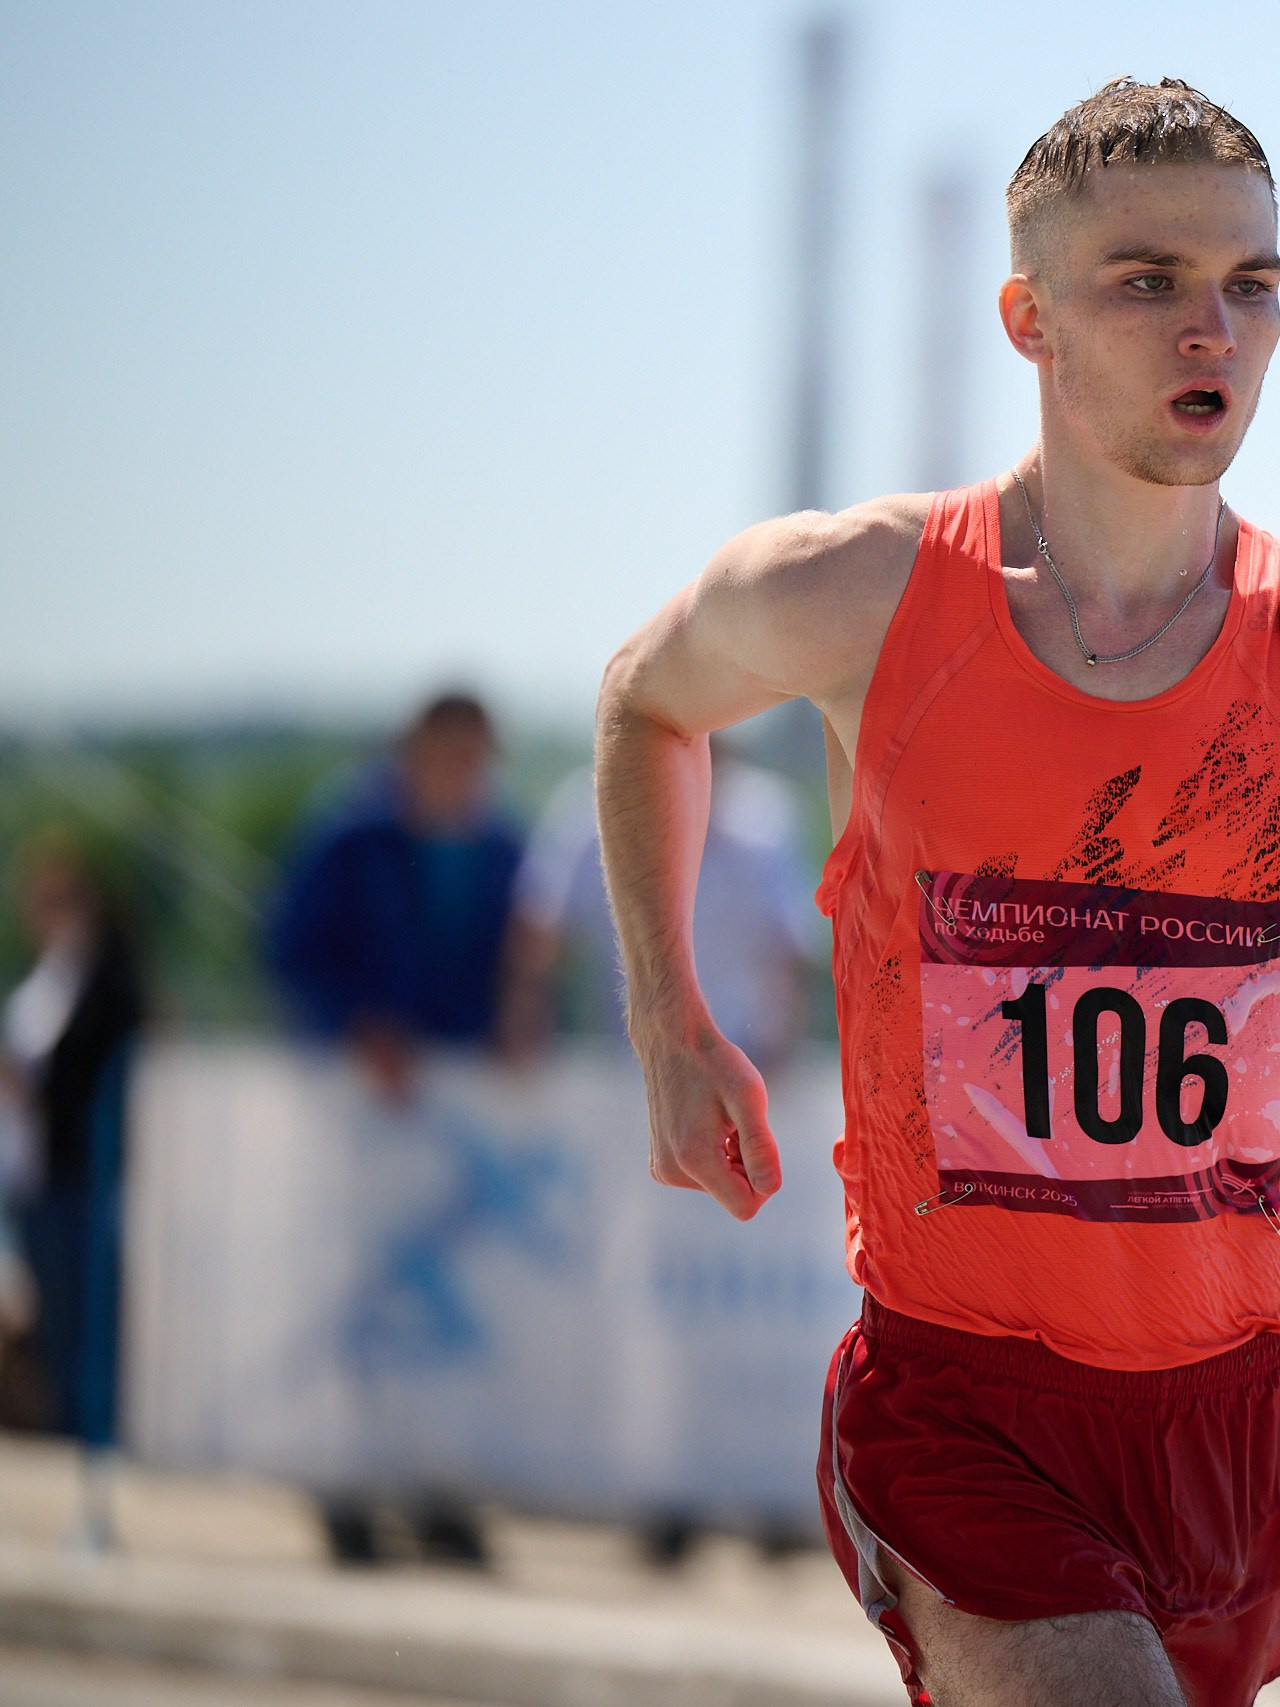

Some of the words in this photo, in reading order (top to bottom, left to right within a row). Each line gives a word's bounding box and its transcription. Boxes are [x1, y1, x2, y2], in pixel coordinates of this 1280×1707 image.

[934, 897, 1130, 931] ЧЕМПИОНАТ
[1141, 916, 1263, 947] РОССИИ
[935, 922, 957, 936] по
[965, 926, 1045, 943] ходьбе
[1002, 983, 1228, 1147] 106
[1041, 1189, 1078, 1207] 2025
